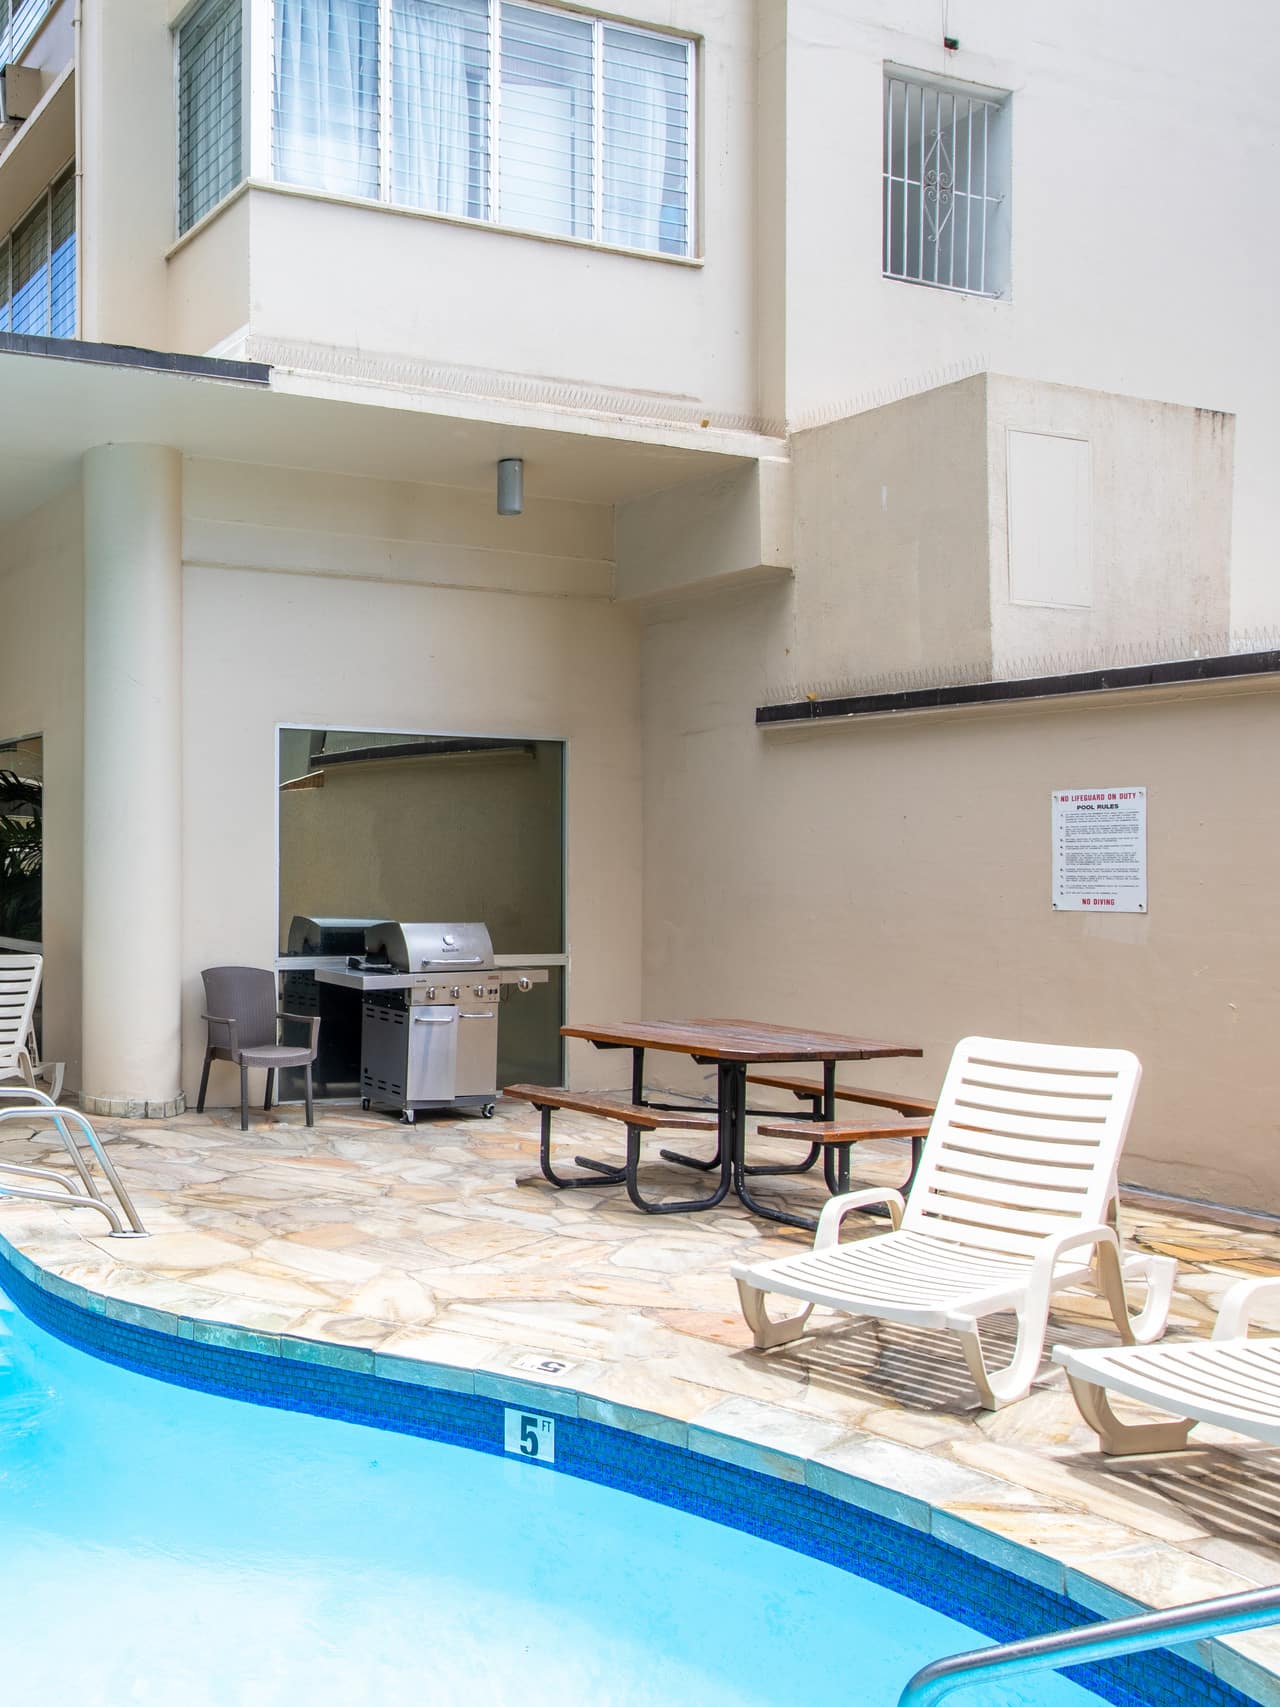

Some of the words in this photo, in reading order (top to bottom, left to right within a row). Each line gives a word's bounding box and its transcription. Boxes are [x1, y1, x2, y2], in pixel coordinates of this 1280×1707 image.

[1071, 794, 1105, 802] LIFEGUARD
[1119, 792, 1137, 800] DUTY
[520, 1415, 539, 1457] 5
[541, 1420, 552, 1433] FT
